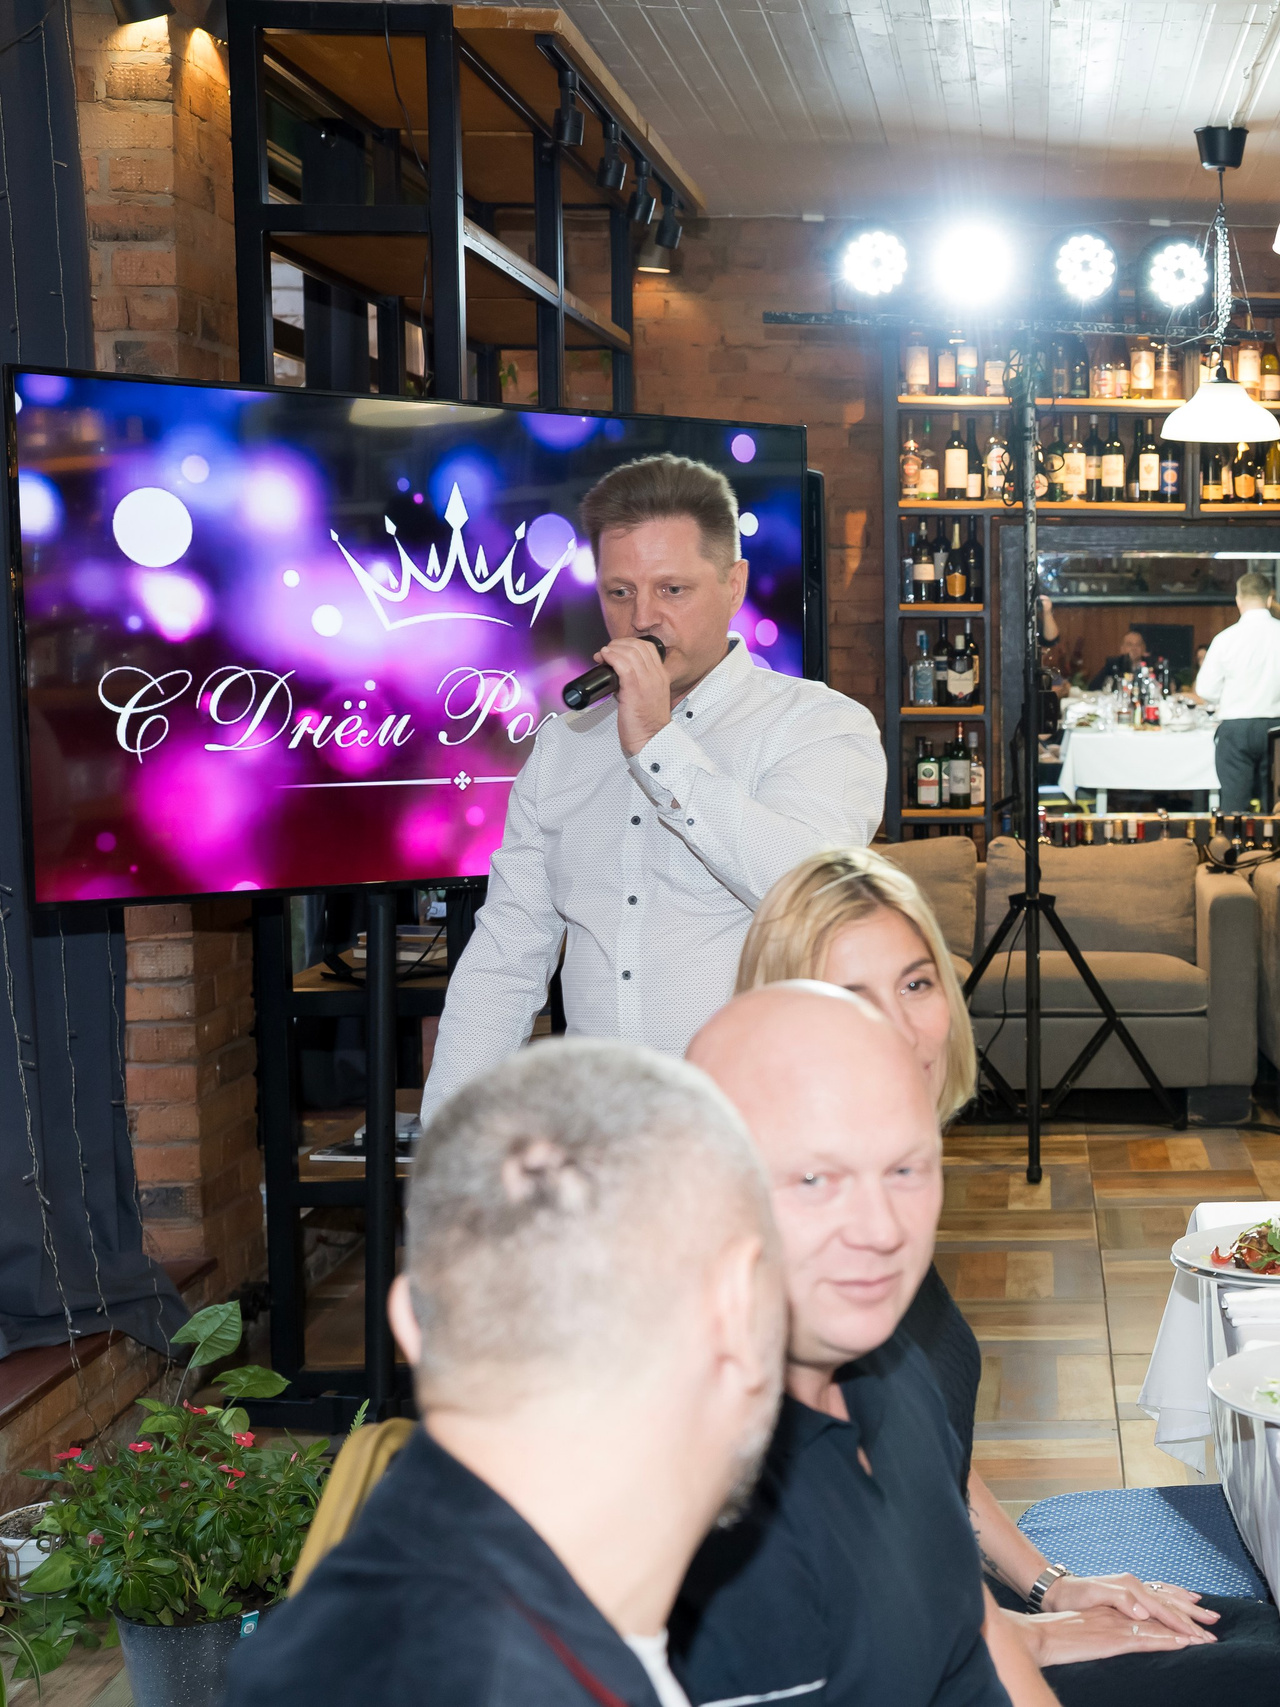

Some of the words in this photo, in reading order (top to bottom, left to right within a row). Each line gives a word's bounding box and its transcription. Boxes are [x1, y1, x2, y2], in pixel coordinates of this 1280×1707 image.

[98, 665, 193, 763] С
[196, 665, 416, 751] Днём
[436, 665, 559, 746] Ро
